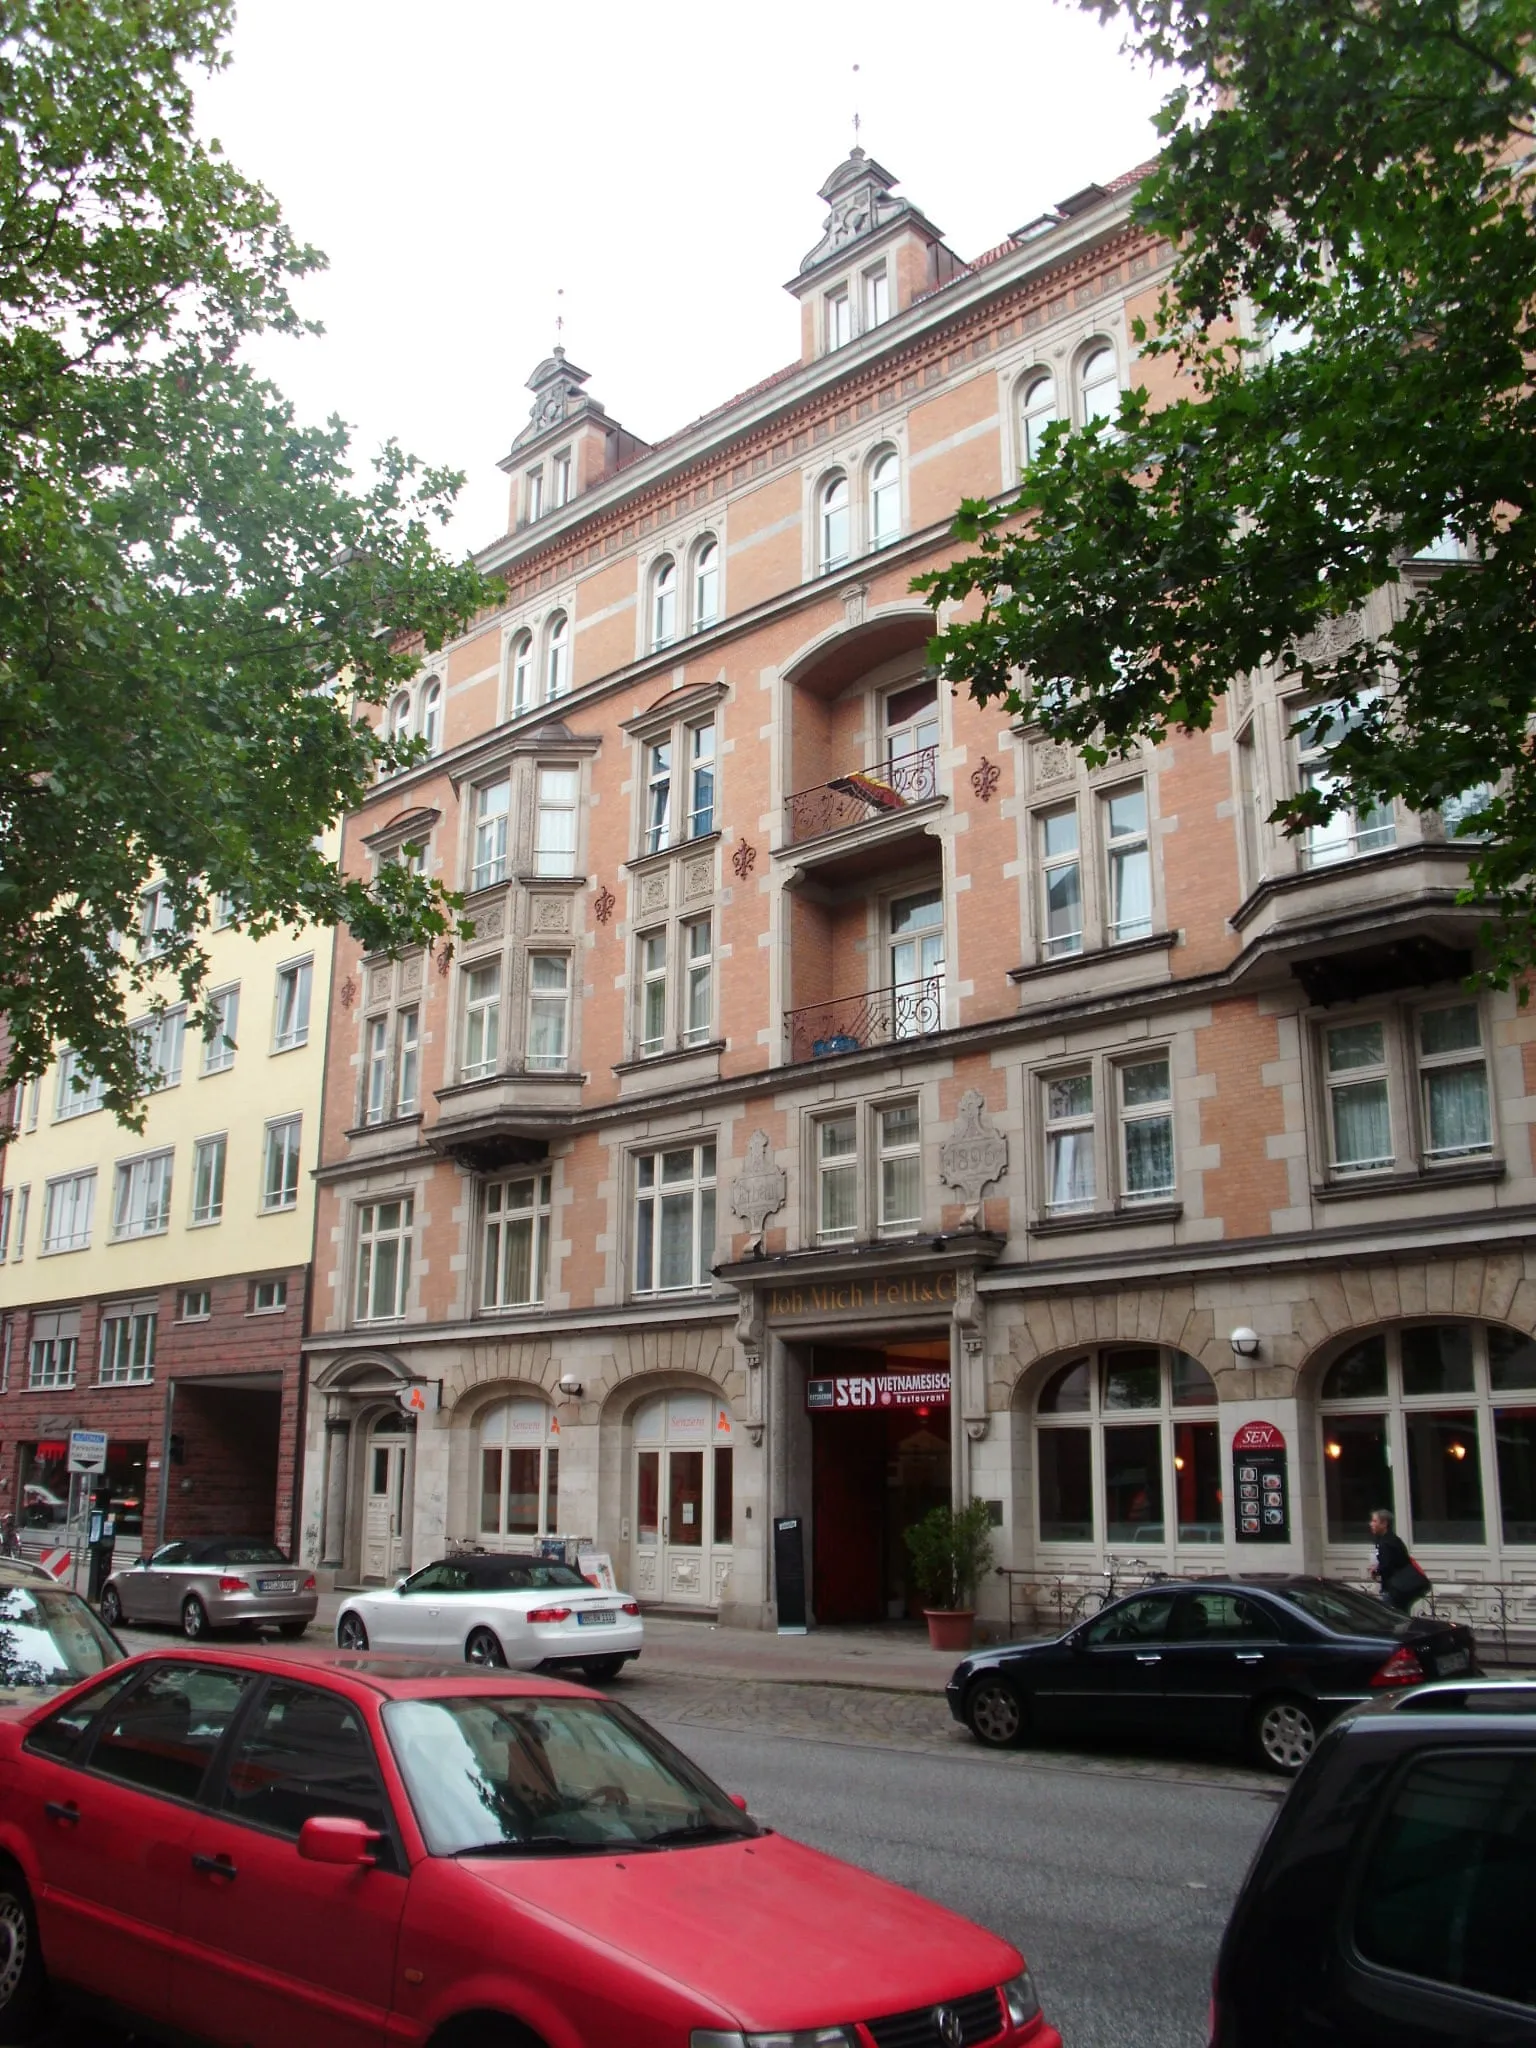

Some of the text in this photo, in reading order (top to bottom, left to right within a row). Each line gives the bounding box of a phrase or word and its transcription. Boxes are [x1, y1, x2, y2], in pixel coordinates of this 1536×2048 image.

[951, 1144, 995, 1172] 1896
[836, 1377, 876, 1407] SEN
[896, 1393, 945, 1404] Restaurant
[1242, 1429, 1274, 1444] SEN
